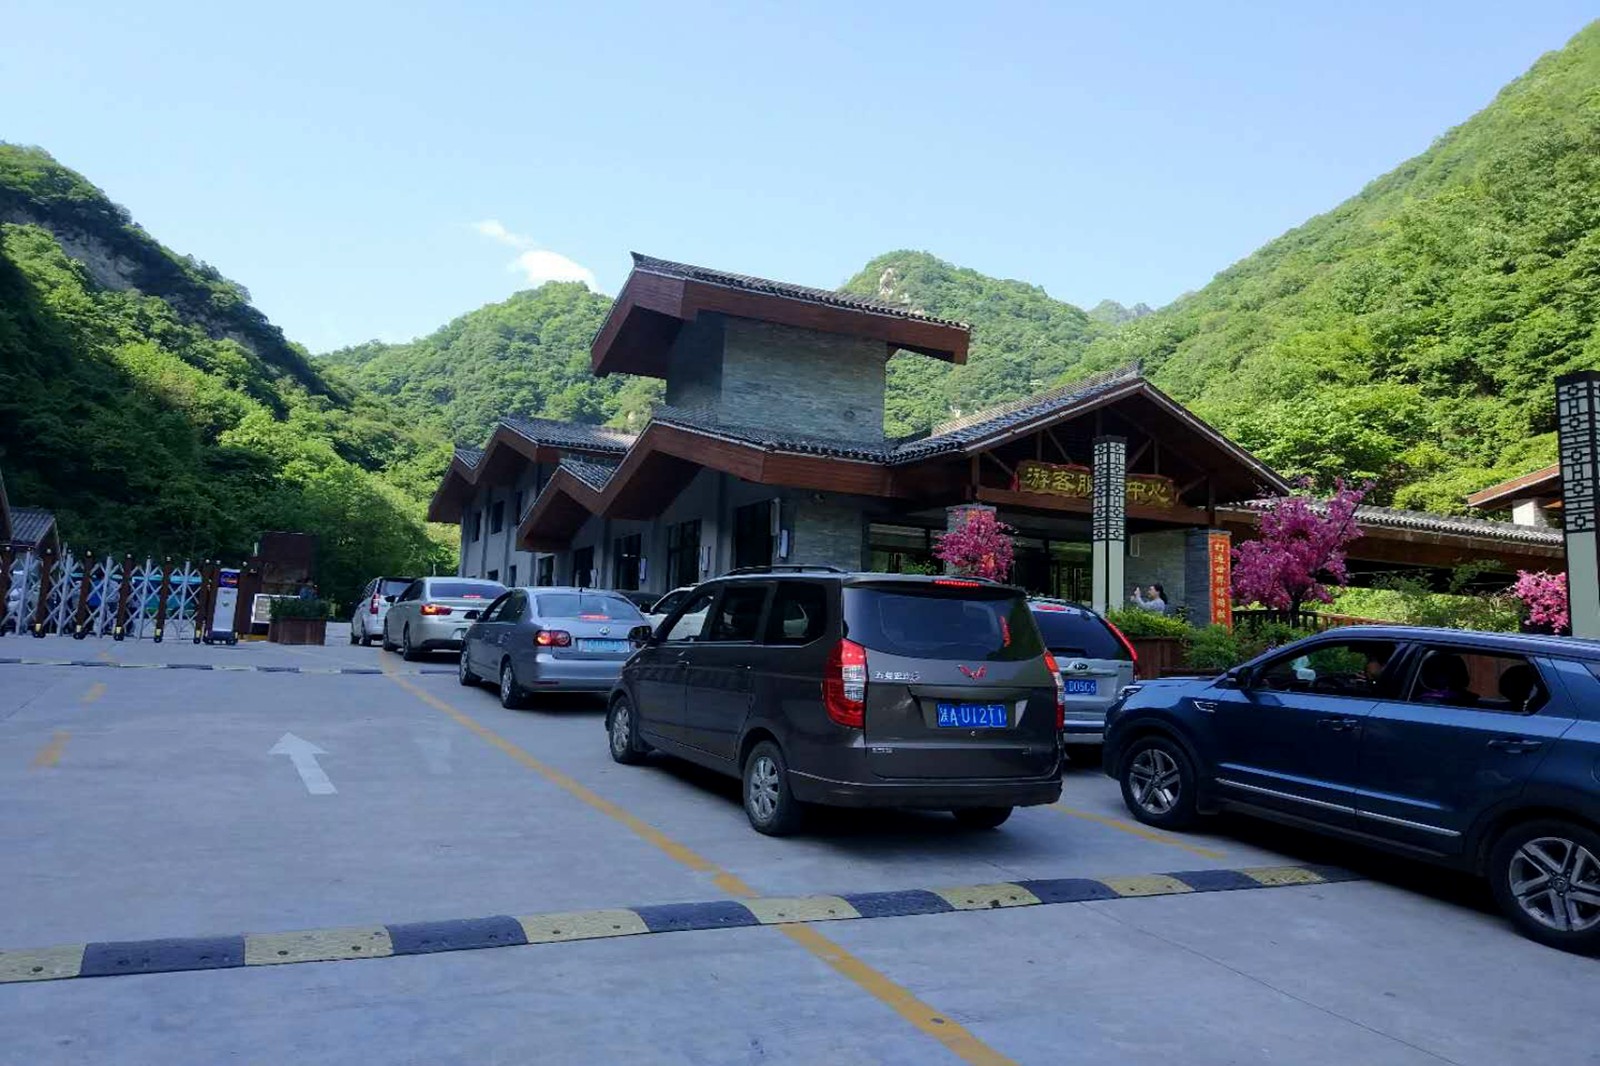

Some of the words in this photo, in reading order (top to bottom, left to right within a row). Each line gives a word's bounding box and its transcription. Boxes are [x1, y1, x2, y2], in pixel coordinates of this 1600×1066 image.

[1026, 467, 1170, 503] 游客服中心
